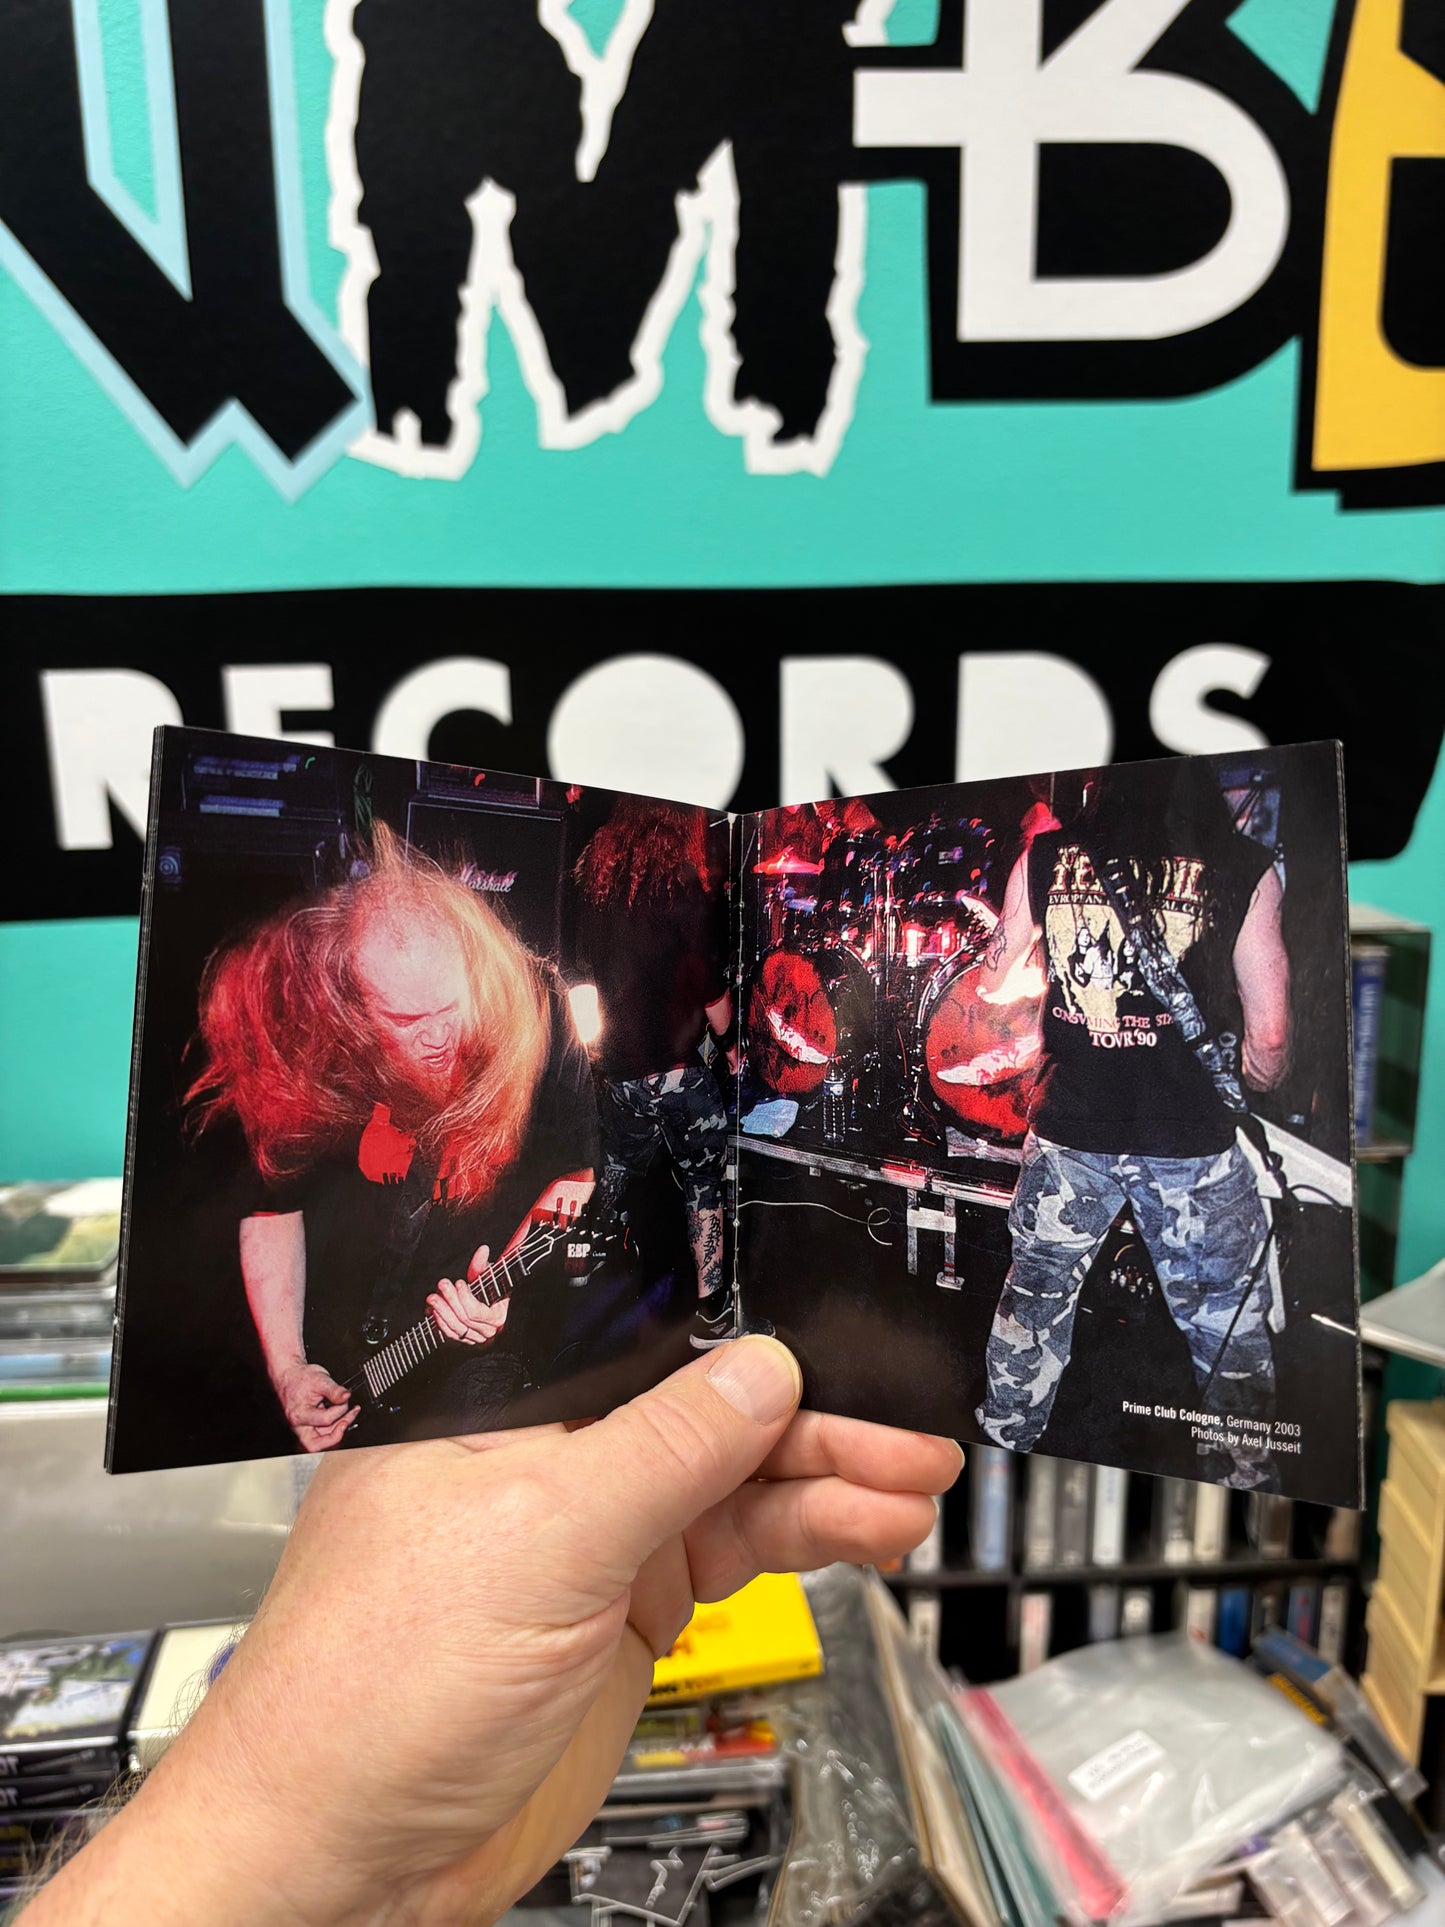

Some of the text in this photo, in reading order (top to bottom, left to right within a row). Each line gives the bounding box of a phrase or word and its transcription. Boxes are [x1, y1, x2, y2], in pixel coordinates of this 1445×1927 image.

[1122, 1015, 1151, 1029] THE
[1122, 1401, 1301, 1437] Prime Club Cologne, Germany 2003
[1191, 1426, 1301, 1454] Photos by Axel Jusseit
